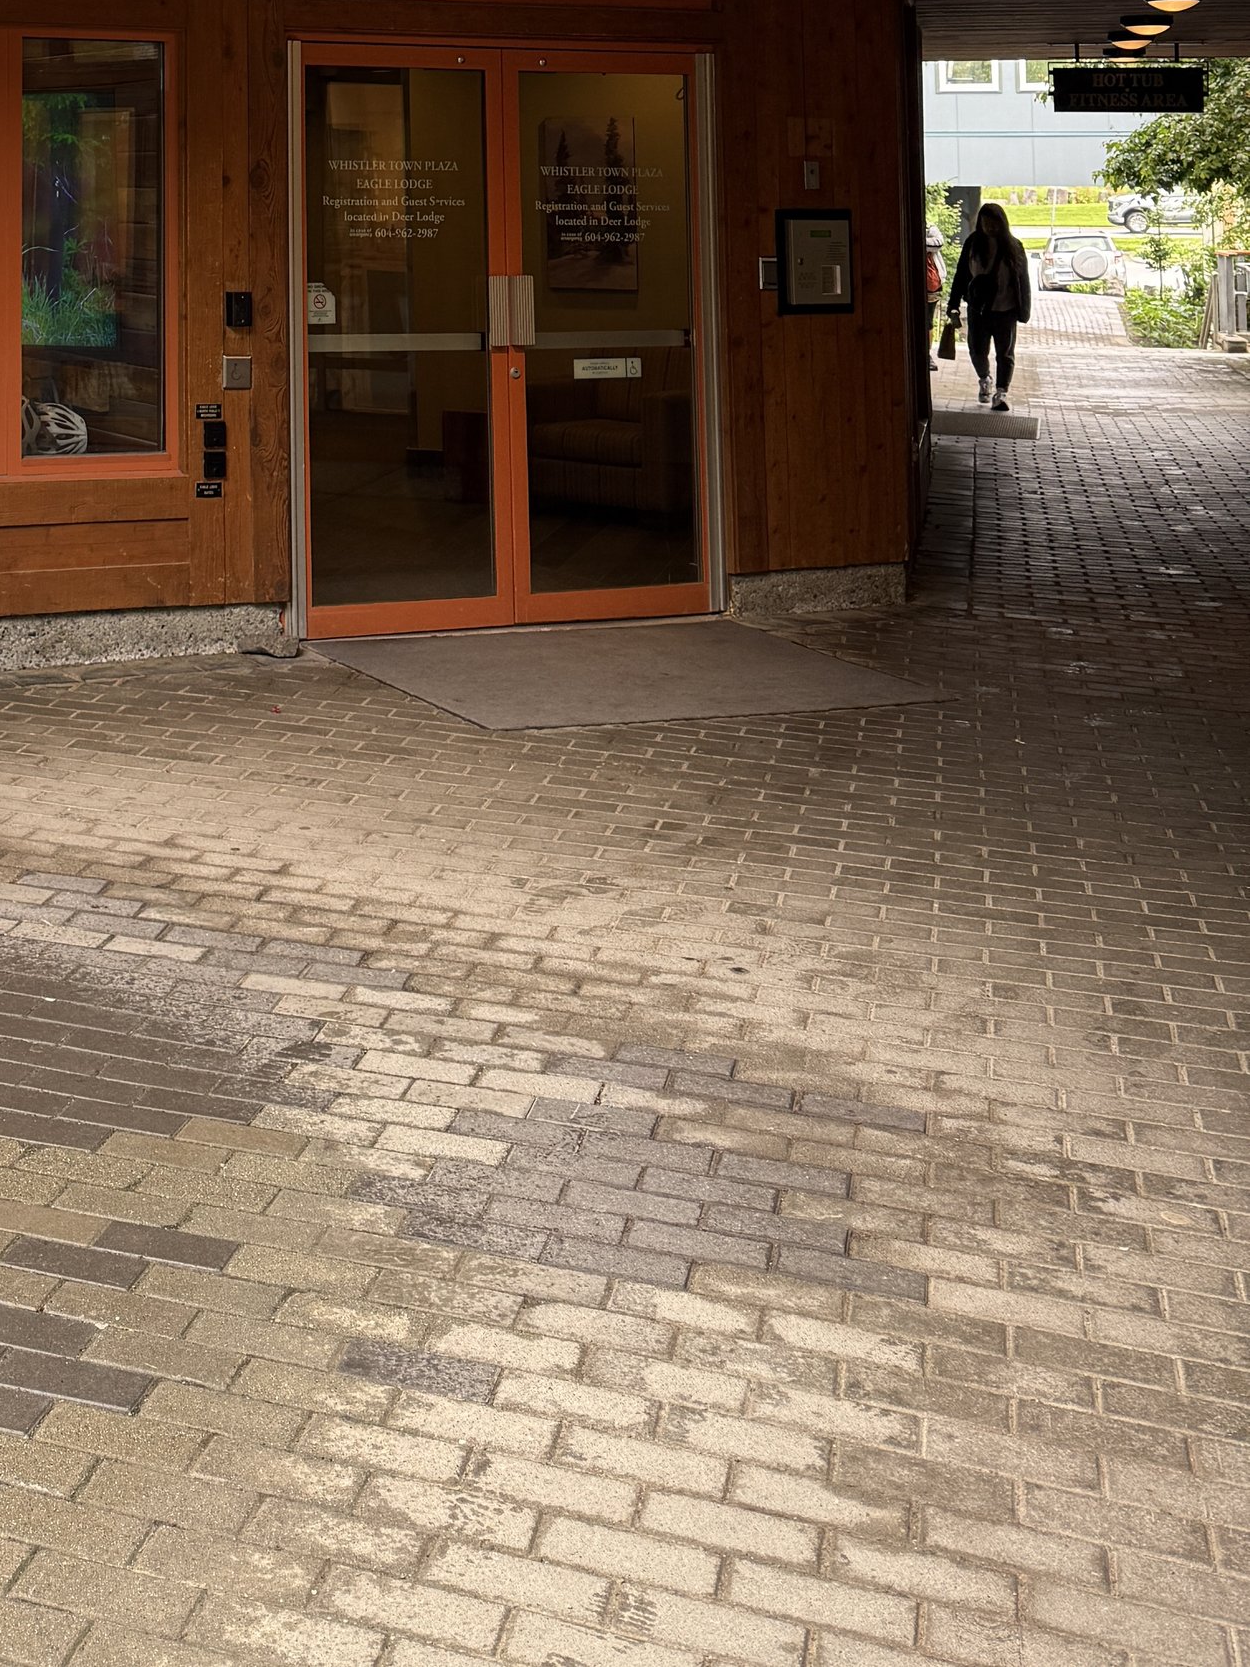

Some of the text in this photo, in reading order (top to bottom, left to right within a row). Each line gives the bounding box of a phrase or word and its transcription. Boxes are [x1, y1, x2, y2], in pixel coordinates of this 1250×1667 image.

[1092, 74, 1164, 87] HOT TUB
[1069, 93, 1188, 107] FITNESS AREA
[329, 160, 458, 171] WHISTLER TOWN PLAZA
[540, 166, 663, 178] WHISTLER TOWN PLAZA
[356, 179, 433, 189] EAGLE LODGE
[567, 184, 638, 195] EAGLE LODGE
[322, 195, 378, 209] Registration
[381, 196, 398, 206] and
[401, 196, 427, 206] Guest
[535, 200, 670, 213] Registration and Guest Services
[344, 211, 445, 224] located in Deer Lodge
[556, 215, 650, 229] located in Deer Lodge
[584, 231, 645, 242] 604-962-2987
